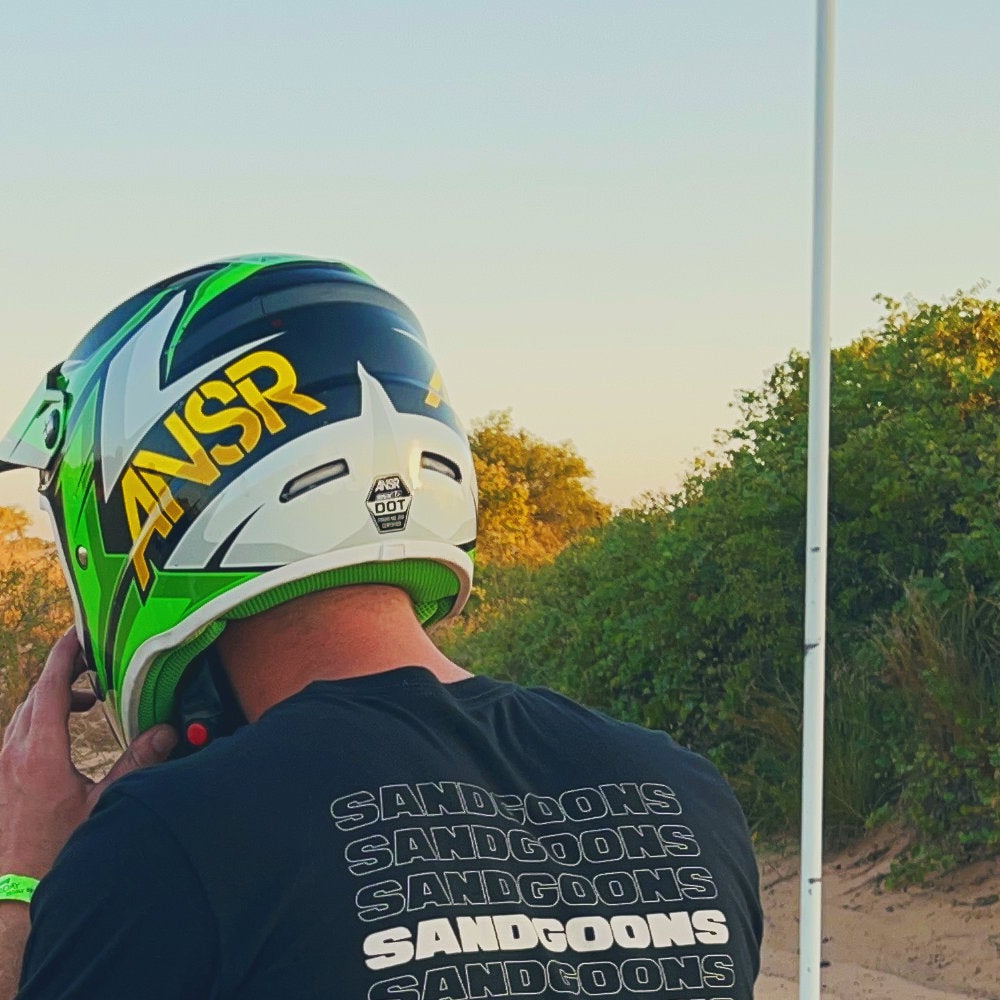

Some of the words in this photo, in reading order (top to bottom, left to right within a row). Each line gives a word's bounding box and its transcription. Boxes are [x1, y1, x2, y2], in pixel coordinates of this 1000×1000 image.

[121, 350, 327, 592] ANSR
[375, 499, 405, 513] DOT
[330, 781, 683, 832] SANDGOONS
[344, 824, 702, 876] SANDGOONS
[355, 866, 719, 922] SANDGOONS
[362, 909, 730, 970] SANDGOONS
